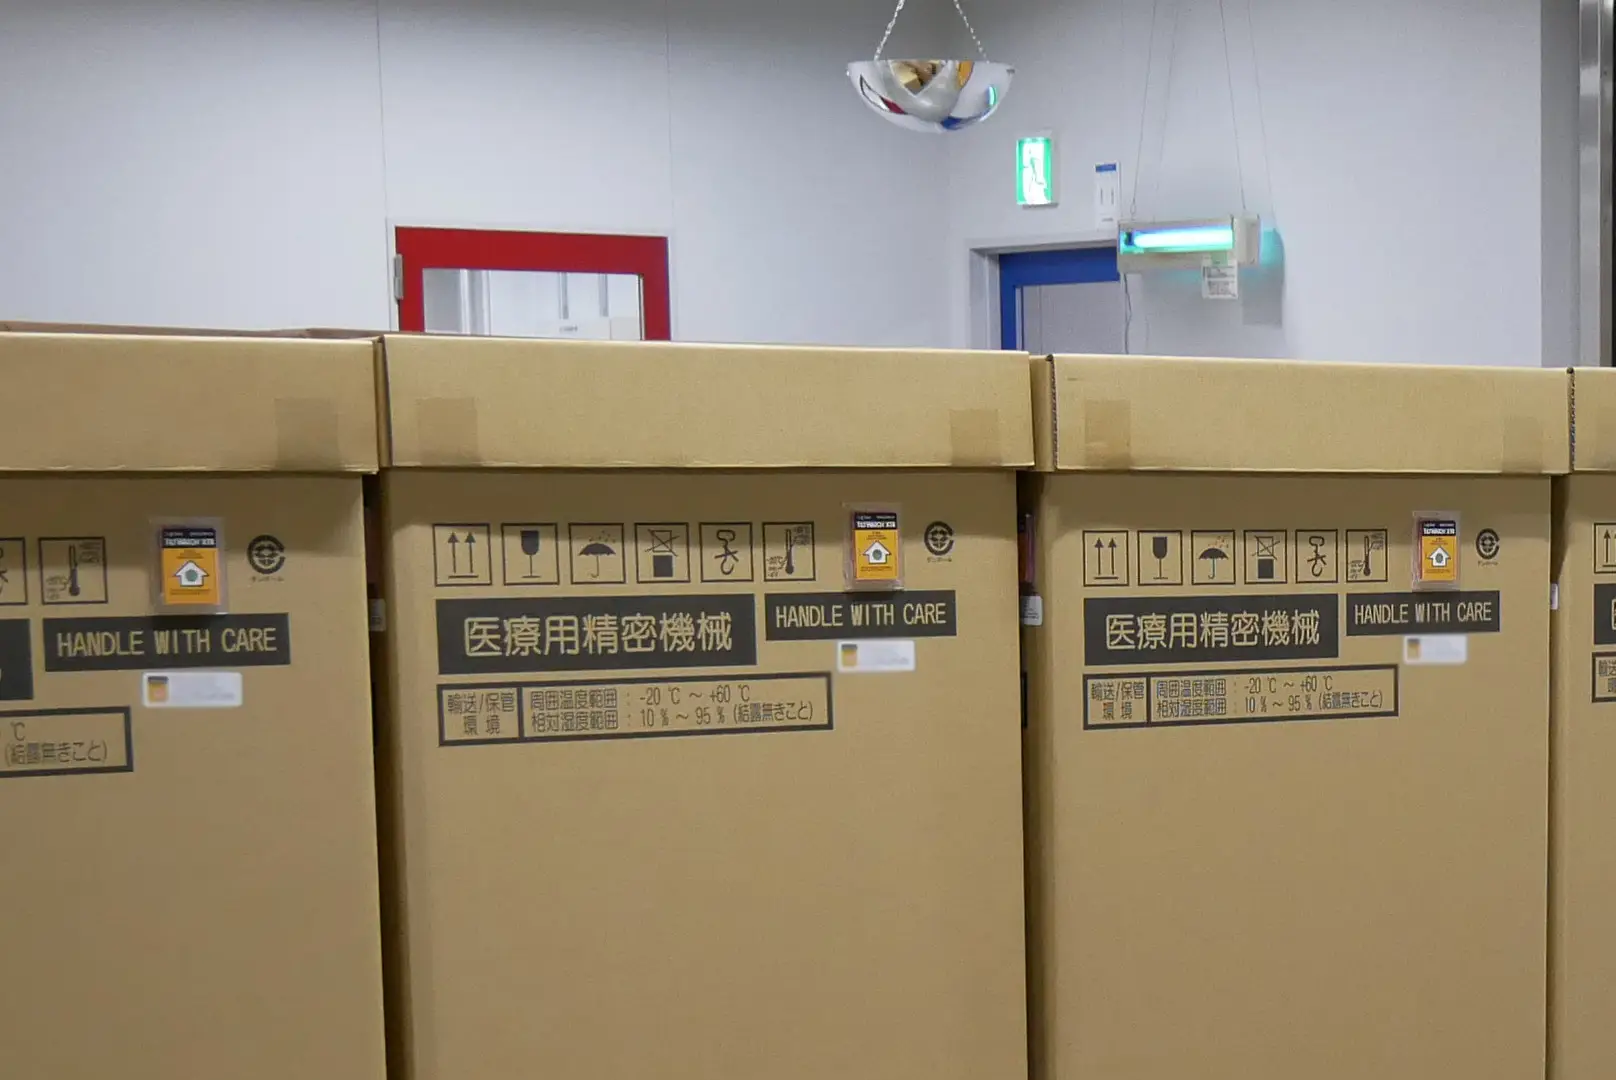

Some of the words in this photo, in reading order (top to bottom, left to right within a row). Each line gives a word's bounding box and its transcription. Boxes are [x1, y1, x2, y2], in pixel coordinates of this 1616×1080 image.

[775, 605, 843, 628] HANDLE
[850, 604, 895, 626] WITH
[903, 602, 947, 624] CARE
[1354, 604, 1408, 625] HANDLE
[1415, 603, 1451, 623] WITH
[1457, 602, 1492, 622] CARE
[57, 631, 144, 657] HANDLE
[154, 629, 210, 655] WITH
[221, 627, 278, 653] CARE
[464, 612, 732, 657] 医療用精密機械
[1105, 610, 1320, 651] 医療用精密機械
[531, 688, 617, 711] 周囲温度範囲
[639, 686, 660, 705] -20
[709, 684, 730, 703] +60
[1244, 677, 1261, 694] -20
[1300, 676, 1317, 692] +60
[640, 708, 654, 727] 10
[695, 706, 711, 725] 95
[1245, 697, 1255, 713] 10
[1288, 695, 1300, 711] 95
